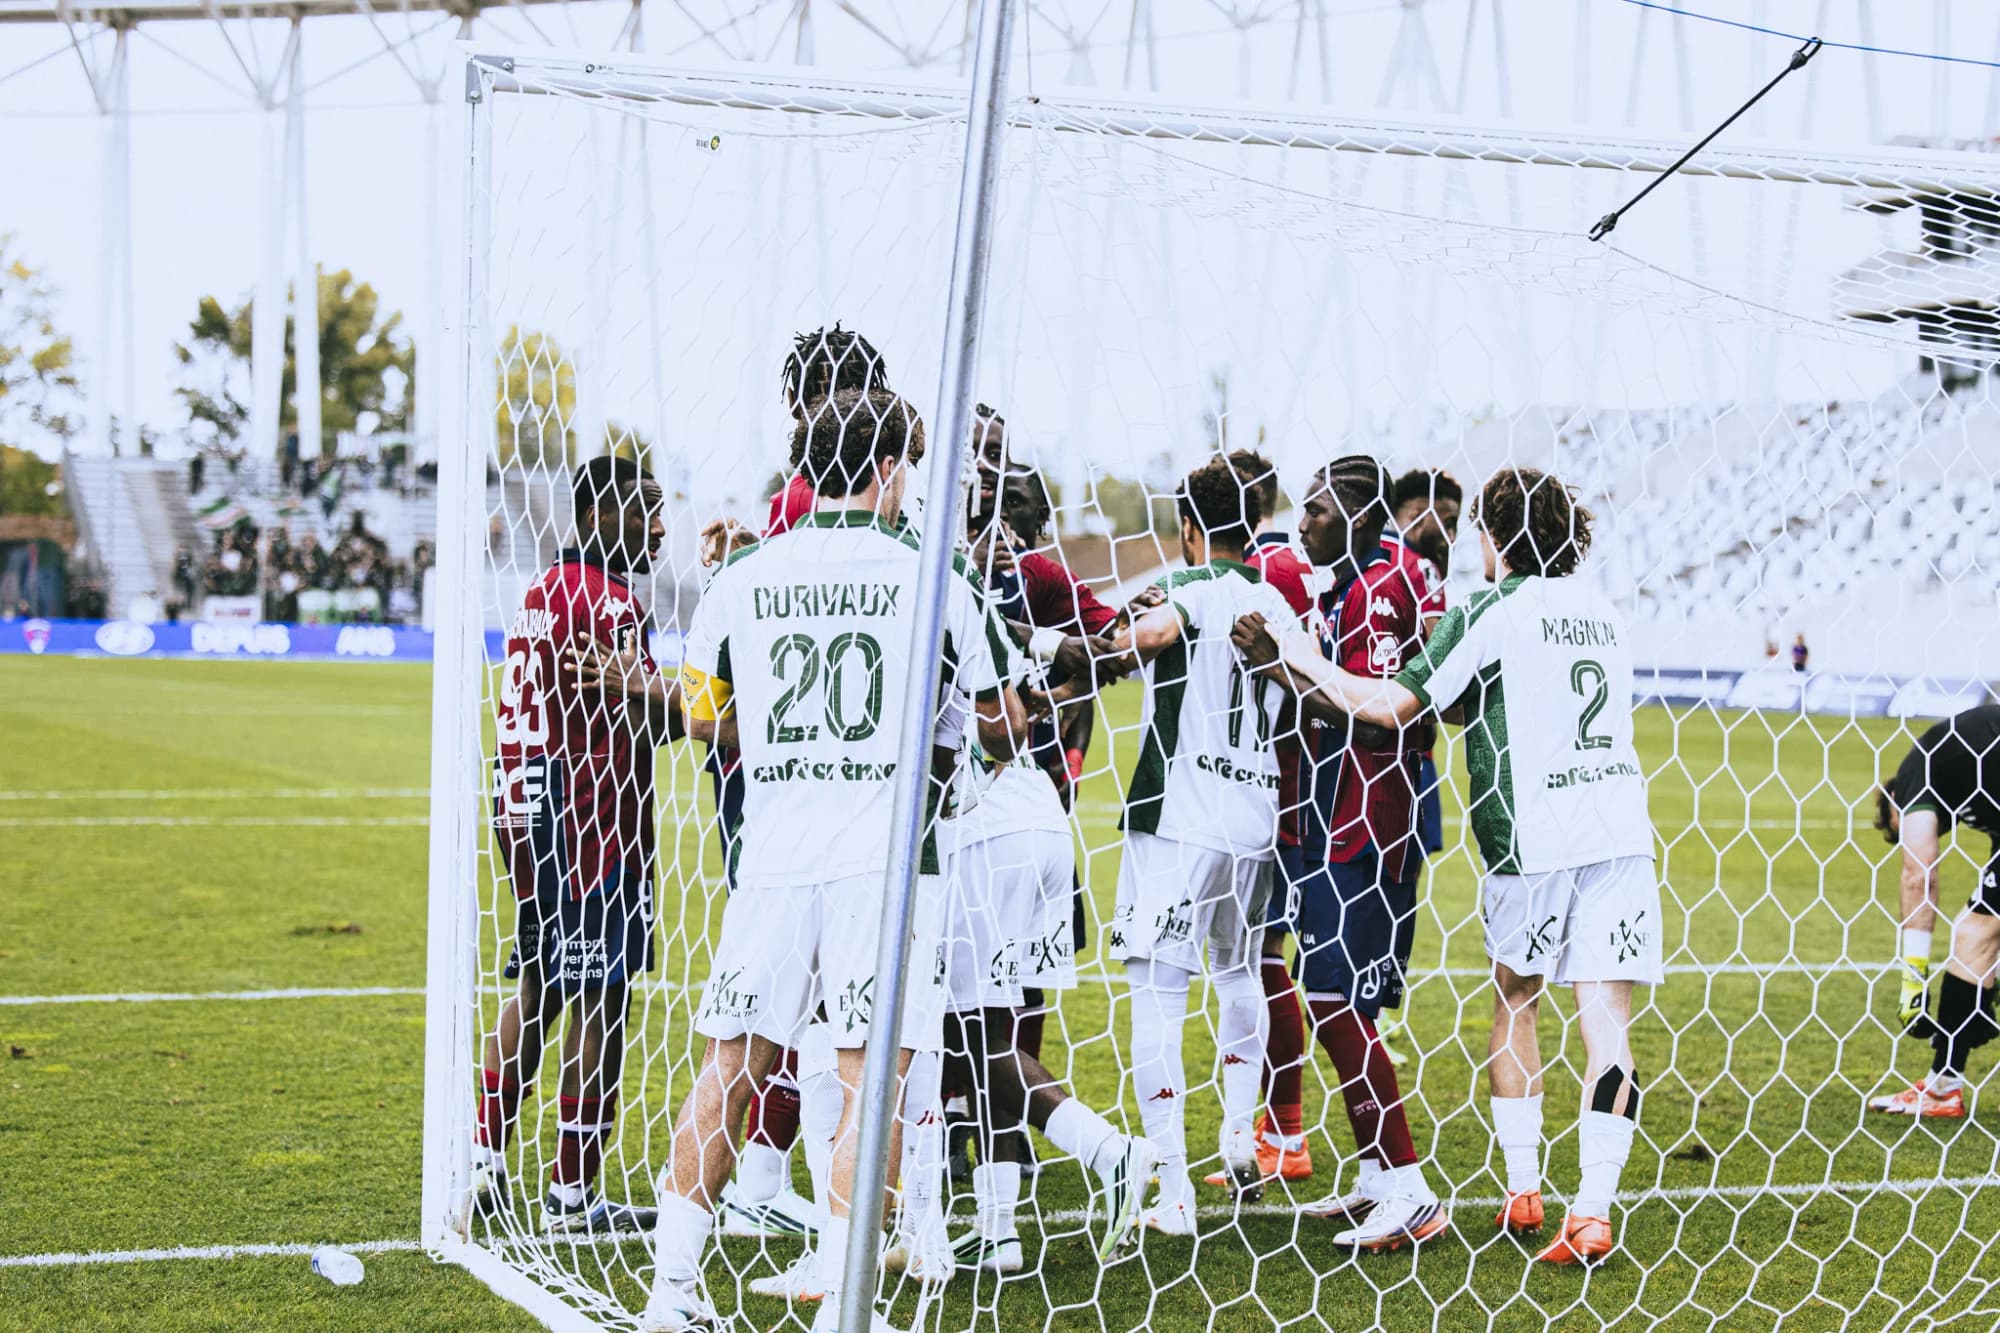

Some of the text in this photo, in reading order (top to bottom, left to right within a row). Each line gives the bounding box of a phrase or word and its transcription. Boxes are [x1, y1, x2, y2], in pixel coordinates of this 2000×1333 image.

[754, 584, 900, 620] DURIVAUX
[498, 650, 550, 746] 93
[767, 632, 883, 744] 20
[1571, 660, 1612, 751] 2
